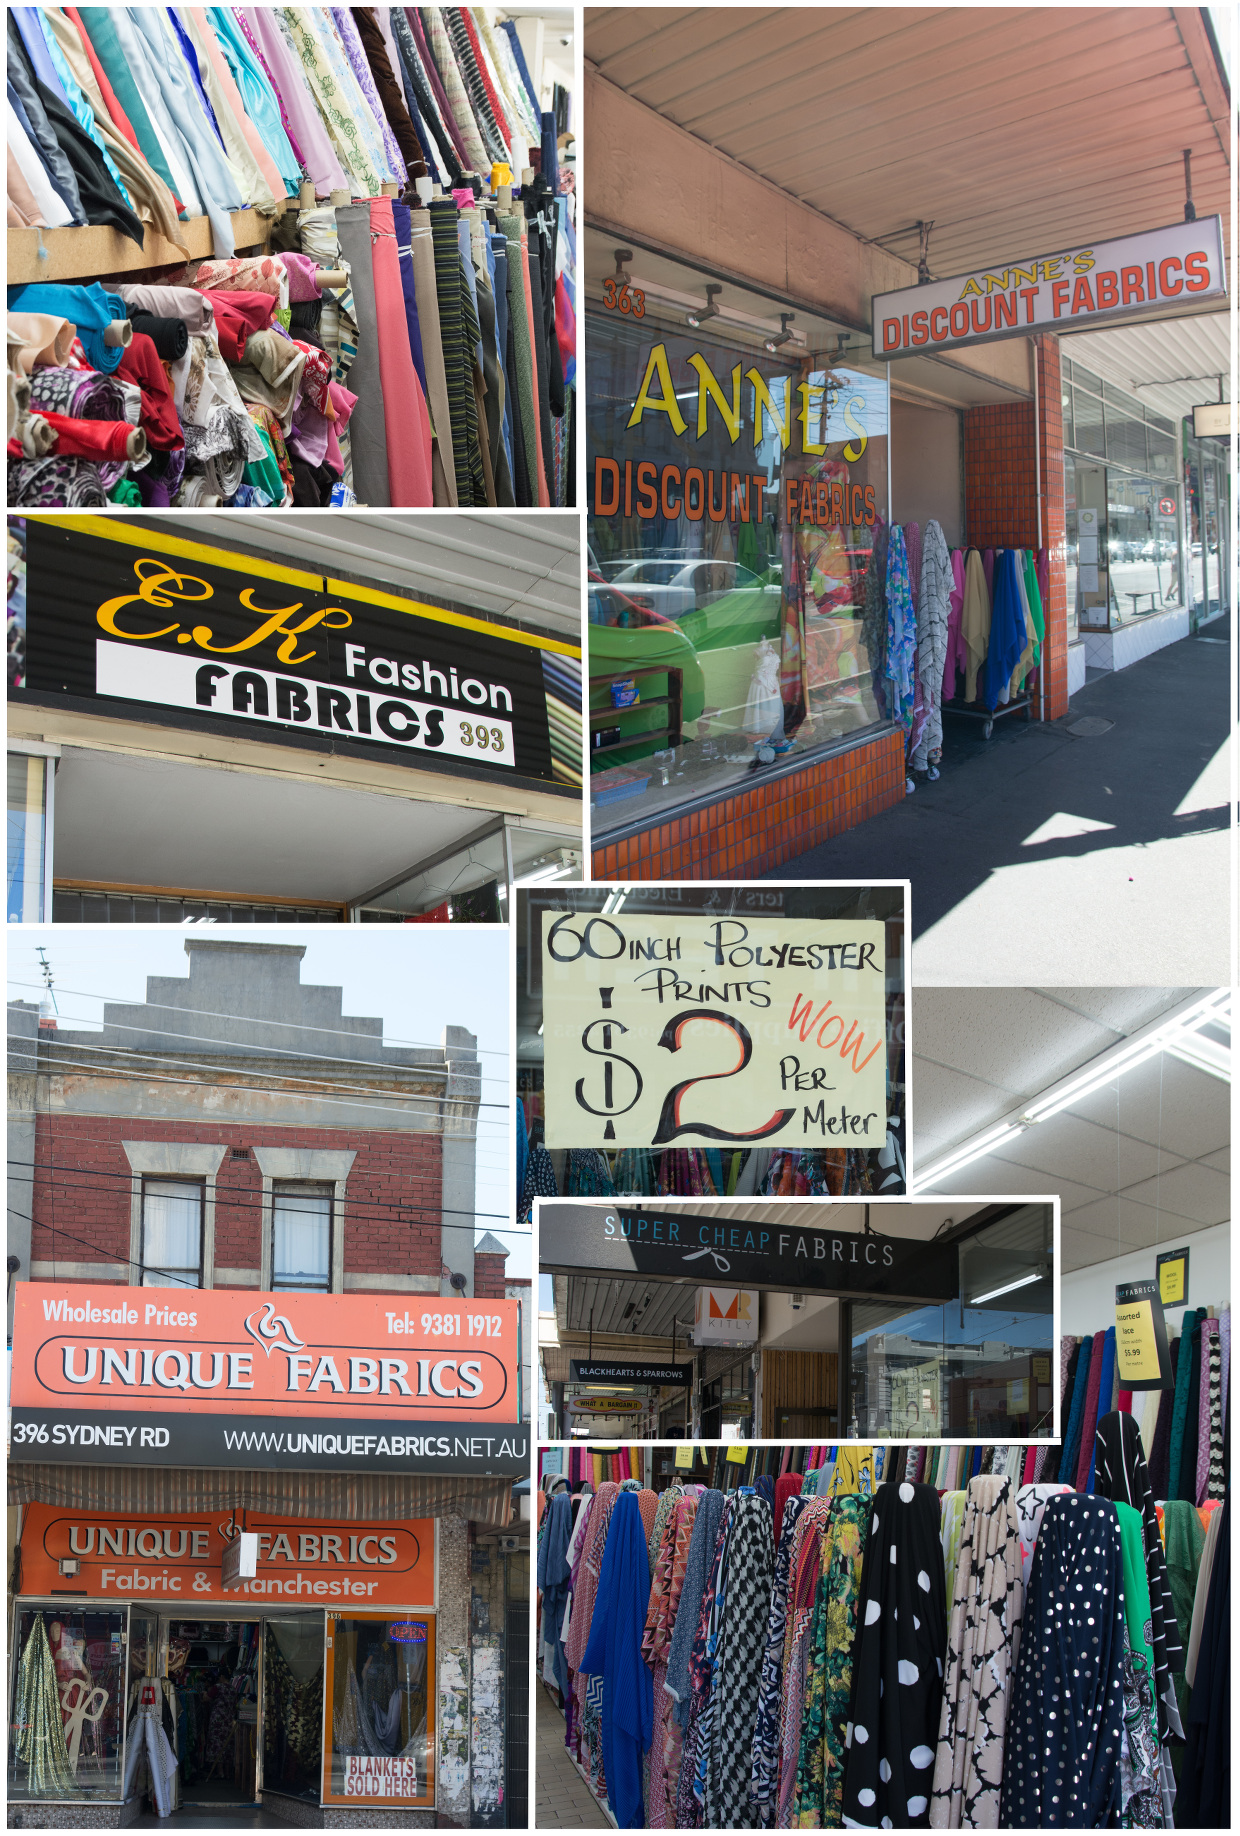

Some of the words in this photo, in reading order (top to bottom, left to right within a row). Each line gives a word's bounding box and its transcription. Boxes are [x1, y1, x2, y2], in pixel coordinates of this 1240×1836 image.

[958, 250, 1097, 302] ANNE'S
[602, 278, 648, 320] 363
[882, 284, 1041, 354] DISCOUNT
[1051, 250, 1211, 320] FABRICS
[624, 342, 870, 465] ANNE'S
[594, 456, 770, 526] DISCOUNT
[786, 478, 877, 527] FABRICS
[345, 643, 514, 713] Fashion
[194, 664, 445, 748] FABRICS
[459, 721, 506, 754] 393
[703, 920, 884, 973] POLYESTER
[633, 967, 772, 1008] PRINTS
[787, 992, 883, 1074] WOW
[801, 1099, 880, 1137] Meter
[604, 1215, 680, 1243] SUPER
[698, 1224, 771, 1250] CHEAP
[777, 1233, 895, 1268] FABRICS
[1125, 1285, 1156, 1297] FABRICS
[43, 1300, 139, 1327] Wholesale
[144, 1304, 198, 1328] Prices
[385, 1313, 415, 1335] Tel:
[420, 1313, 461, 1337] 9381
[466, 1315, 503, 1338] 1912
[708, 1318, 752, 1330] KITLY
[61, 1345, 255, 1392] UNIQUE
[286, 1354, 484, 1399] FABRICS
[580, 1367, 634, 1377] BLACKHEARTS
[643, 1370, 683, 1379] SPARROWS
[579, 1400, 597, 1408] WHAT
[607, 1401, 633, 1409] BARGAIN
[13, 1424, 49, 1444] 396
[51, 1424, 138, 1447] SYDNEY
[140, 1426, 170, 1448] RD
[223, 1430, 527, 1459] WWW.UNIQUEFABRICS.NET.AU
[68, 1526, 211, 1560] UNIQUE
[256, 1532, 398, 1566] FABRICS
[100, 1568, 182, 1592] Fabric
[191, 1571, 212, 1592] &
[389, 1625, 428, 1639] OPEN
[349, 1757, 414, 1776] BLANKETS
[346, 1776, 382, 1796] SOLD
[383, 1777, 417, 1797] HERE
